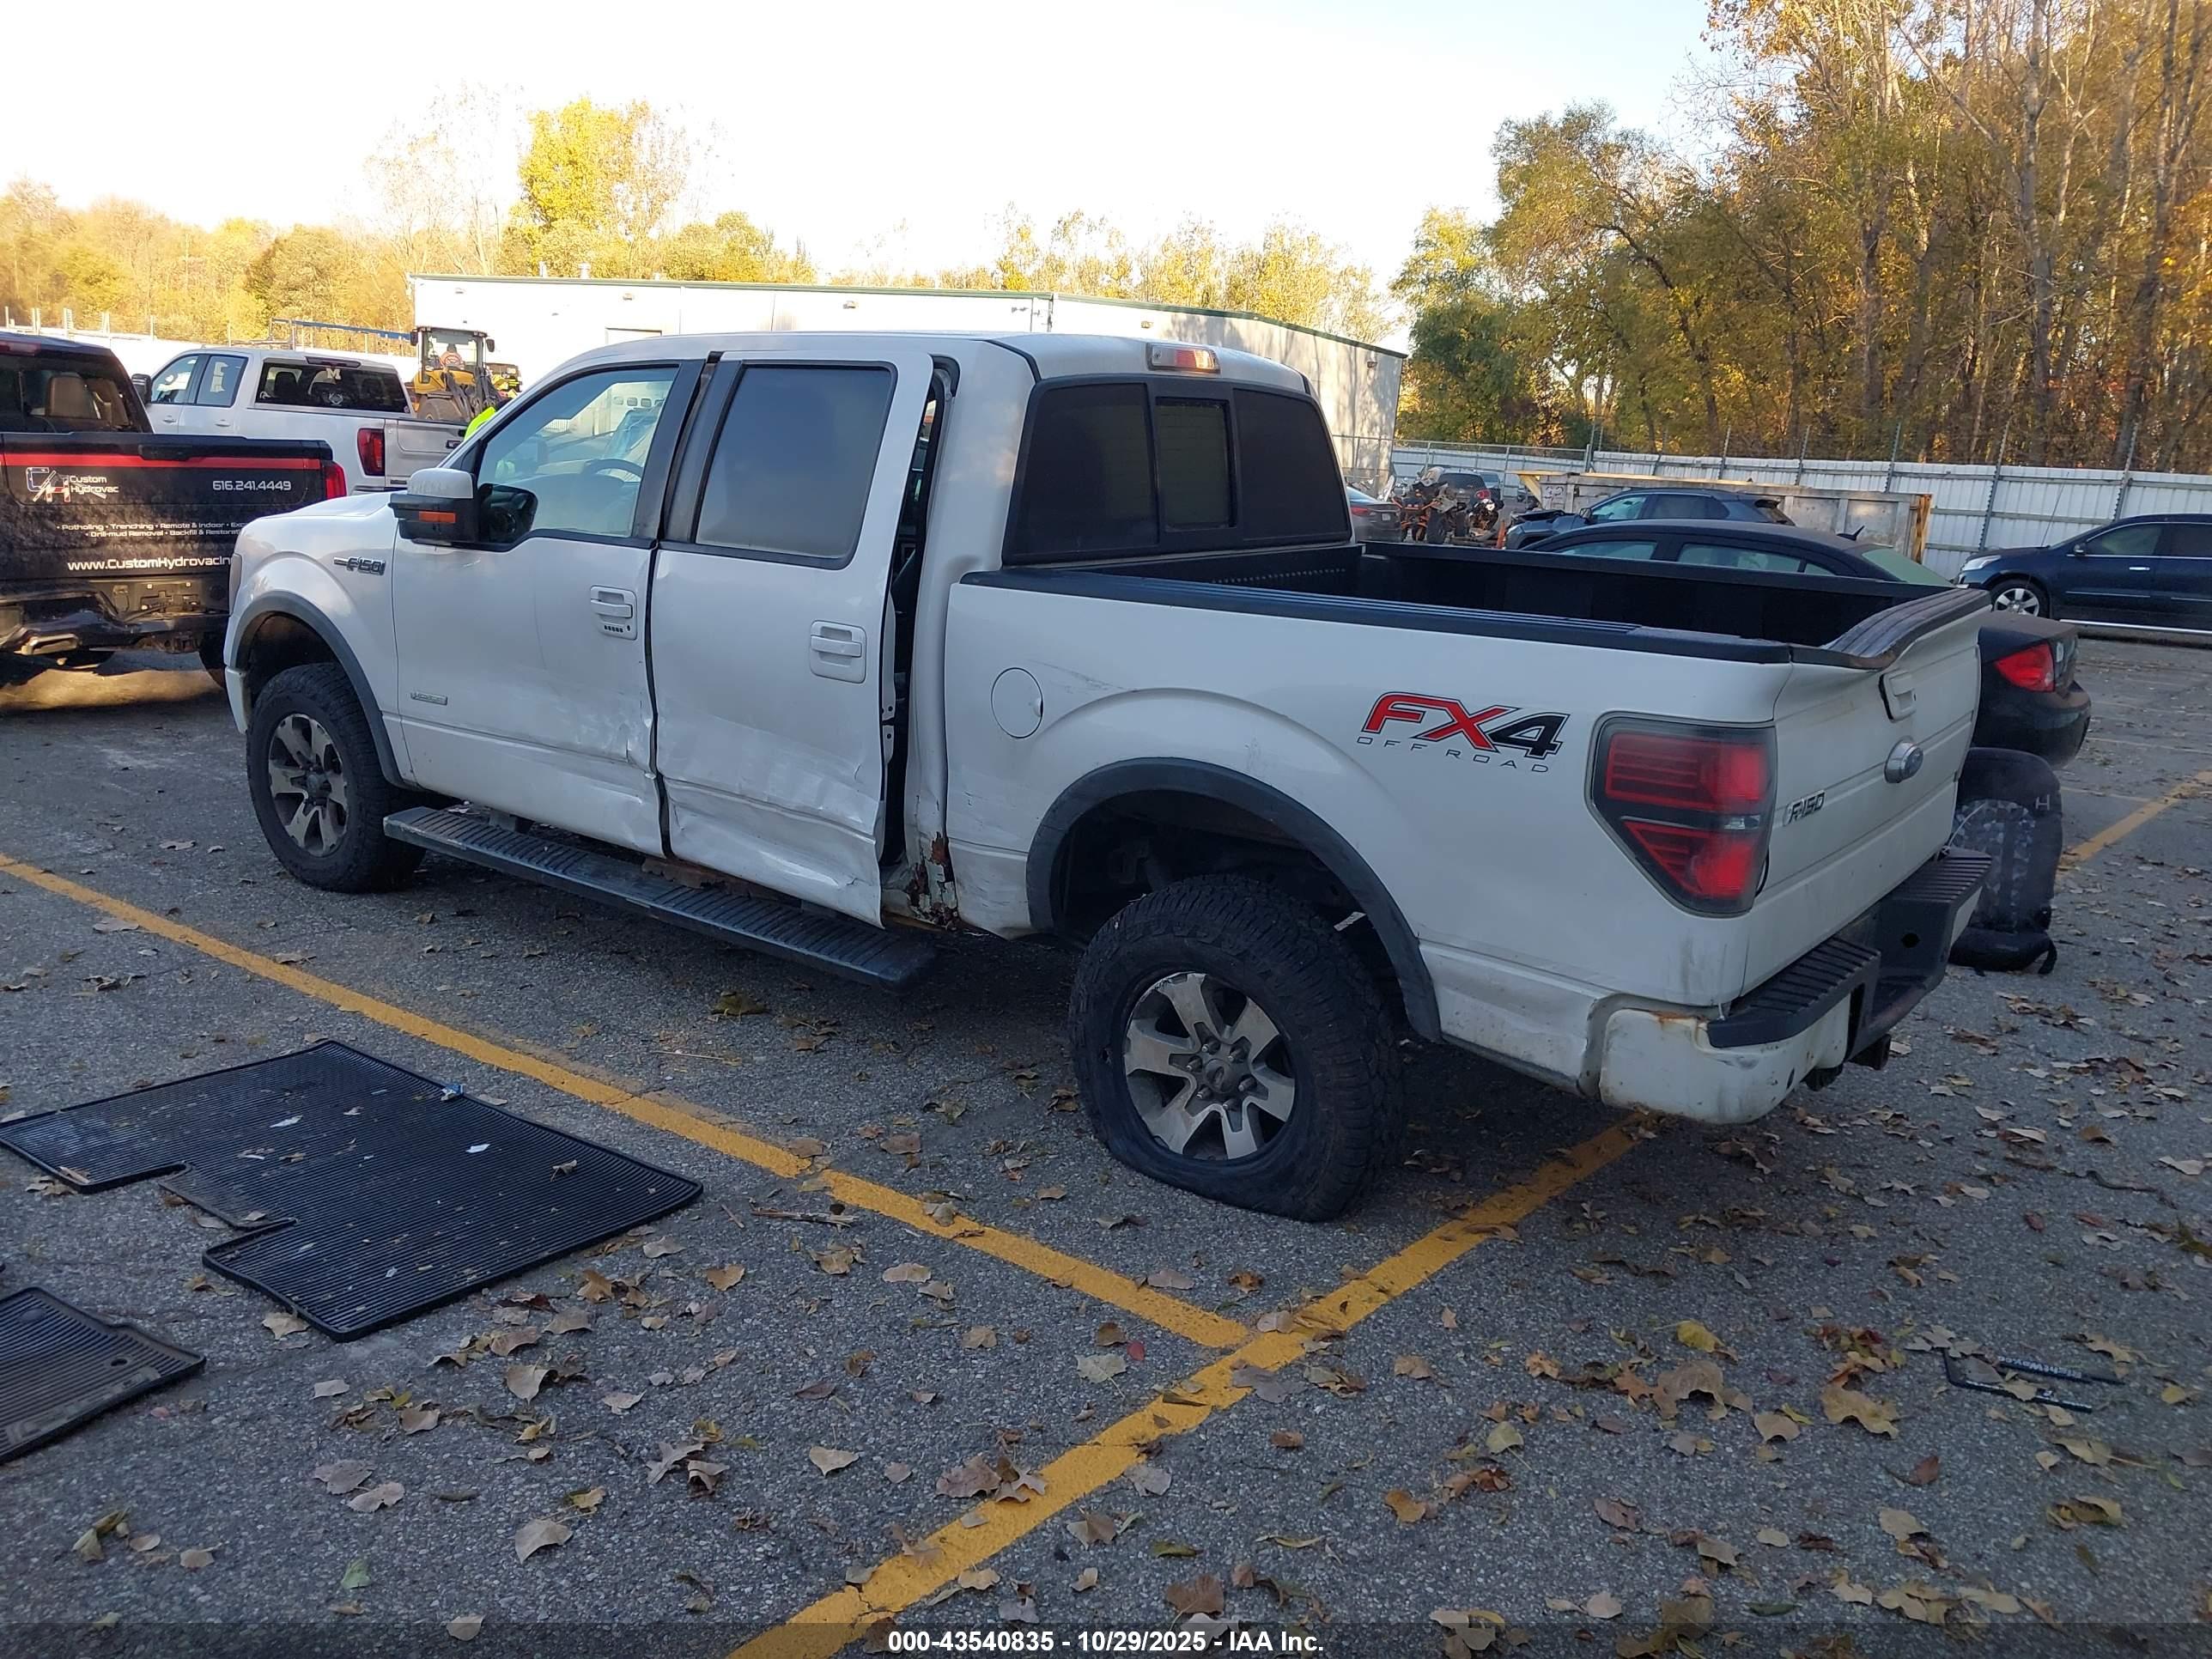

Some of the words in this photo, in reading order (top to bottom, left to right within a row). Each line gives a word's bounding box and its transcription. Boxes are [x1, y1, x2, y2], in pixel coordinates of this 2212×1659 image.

[326, 368, 342, 380] M
[70, 475, 107, 483] Custom
[70, 484, 119, 495] Hydrovac
[212, 480, 292, 491] 616.241.4449
[1360, 691, 1571, 760] FX4
[1445, 749, 1550, 774] ROAD
